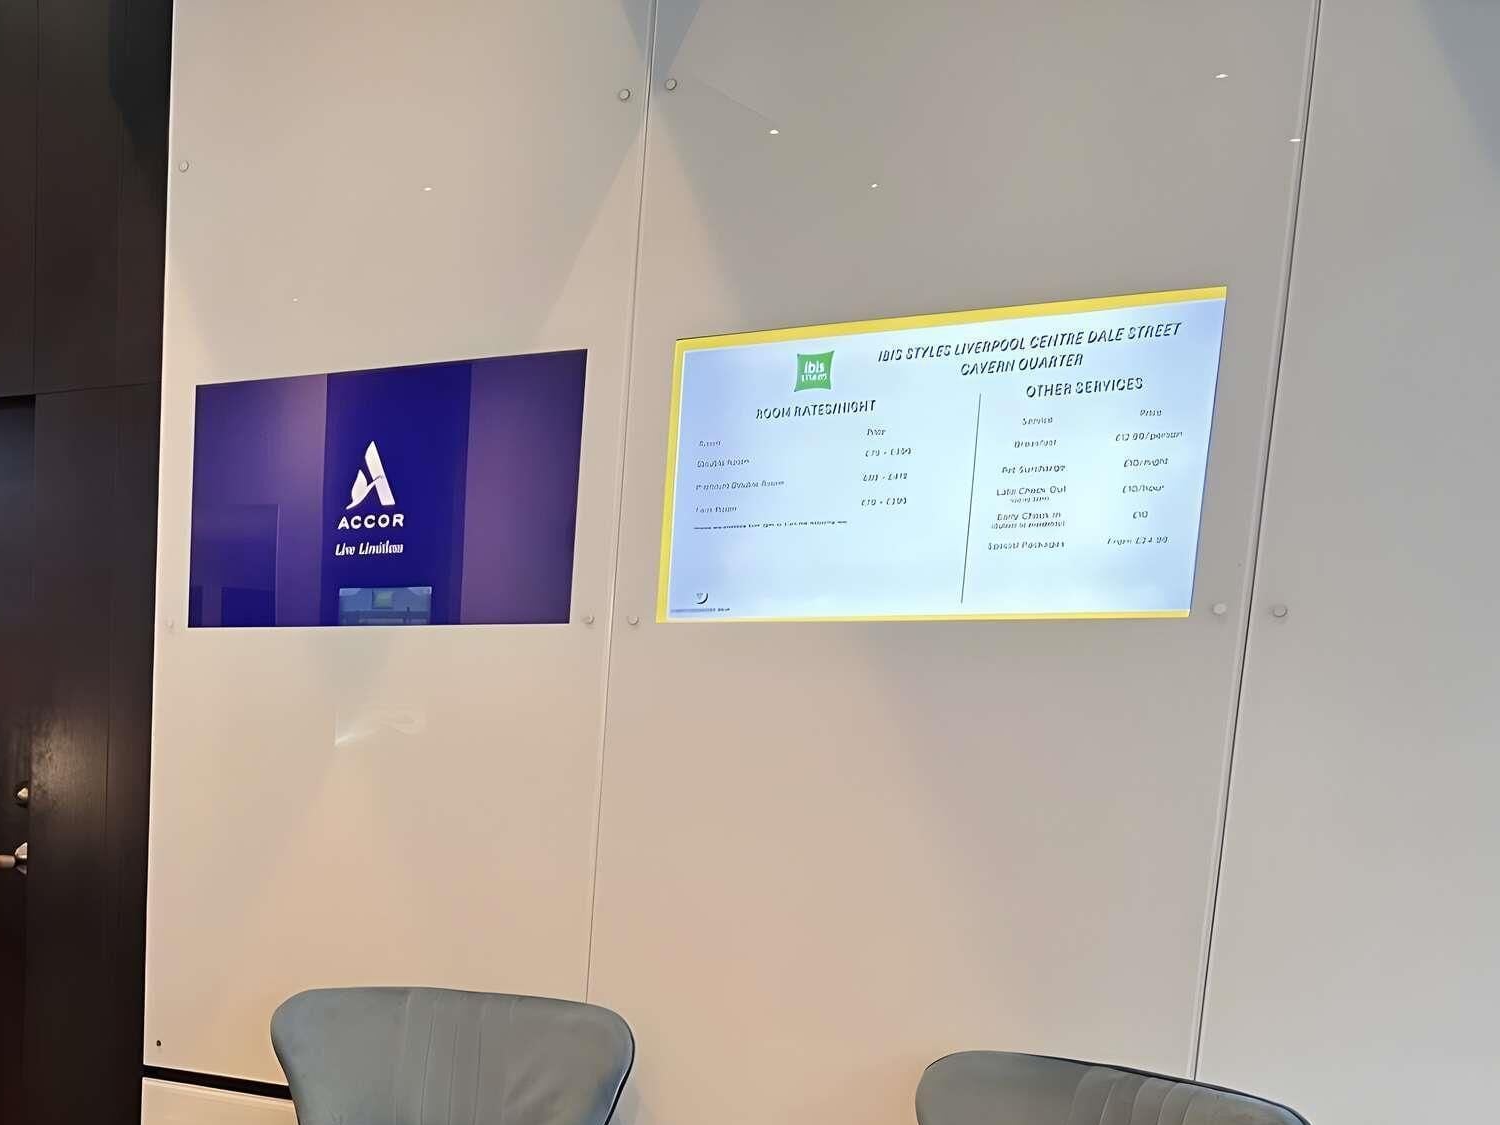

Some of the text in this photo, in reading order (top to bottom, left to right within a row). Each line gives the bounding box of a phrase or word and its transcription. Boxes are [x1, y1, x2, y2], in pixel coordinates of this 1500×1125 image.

[878, 322, 1182, 362] IBIS STYLES LIVERPOOL CENTRE DALE STREET
[803, 360, 826, 373] ibis
[961, 354, 1083, 376] CAVERN QUARTER
[1026, 377, 1144, 398] OTHER SERVICES
[755, 406, 791, 420] ROOM
[337, 513, 405, 529] ACCOR
